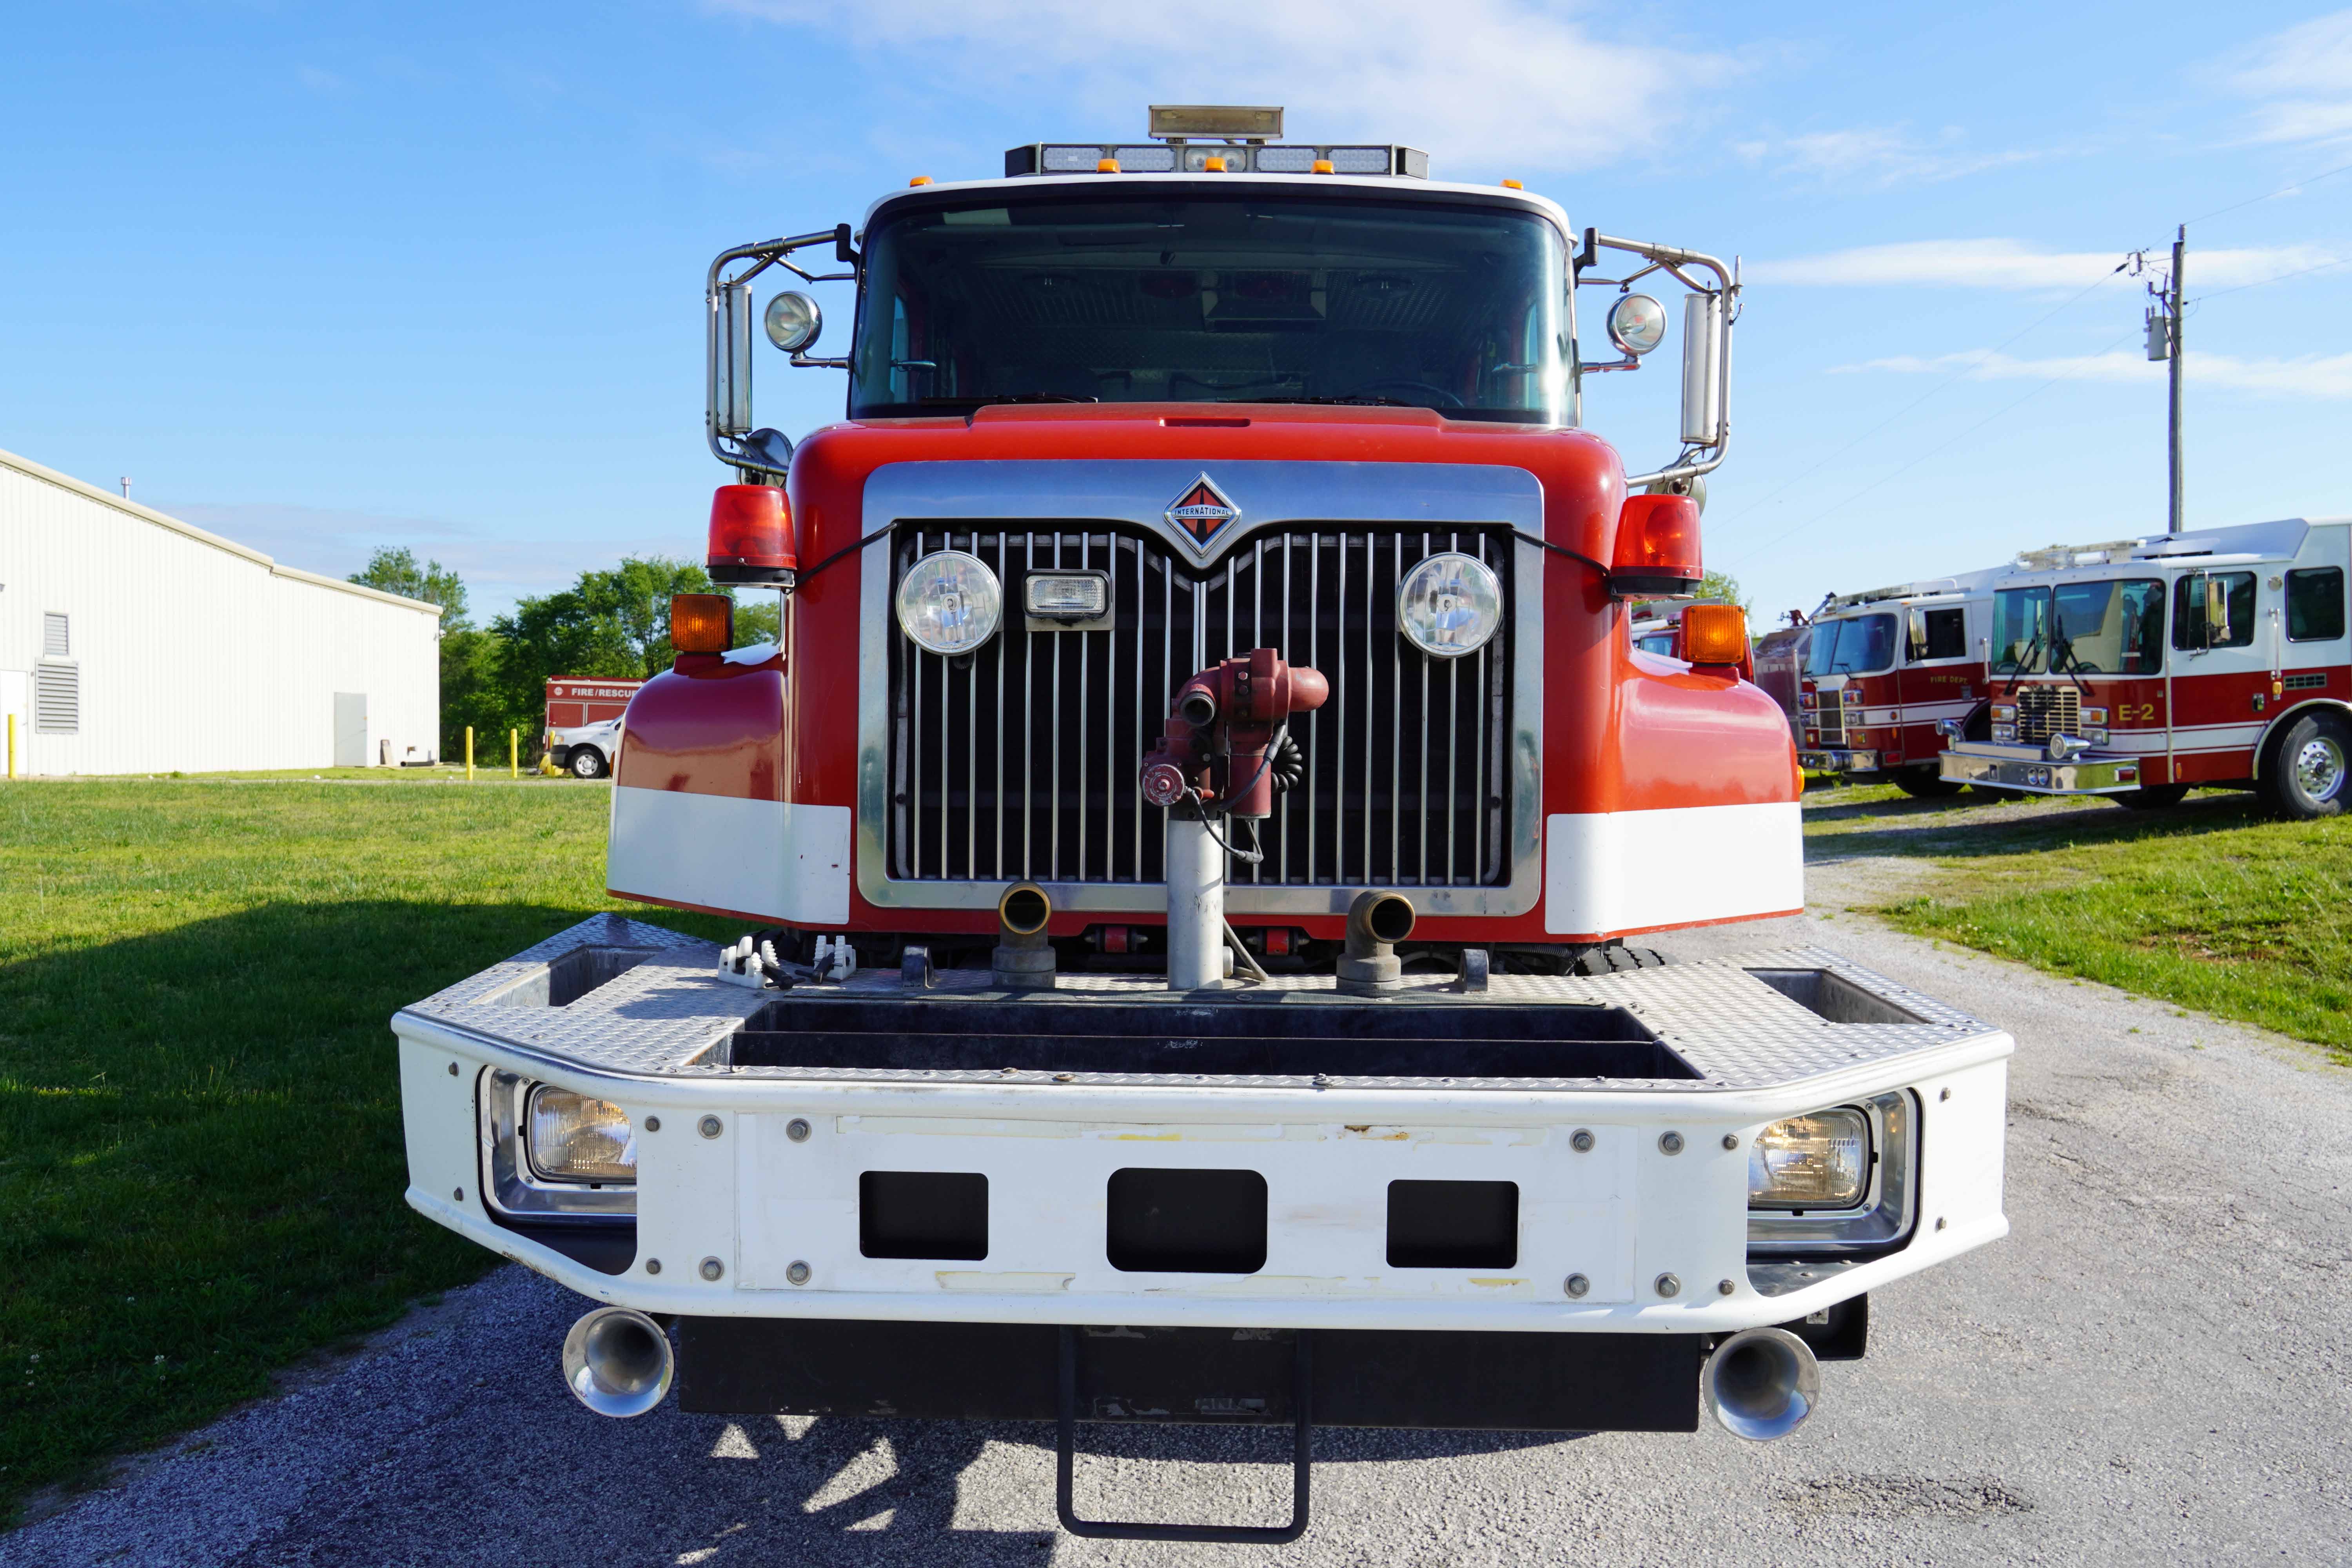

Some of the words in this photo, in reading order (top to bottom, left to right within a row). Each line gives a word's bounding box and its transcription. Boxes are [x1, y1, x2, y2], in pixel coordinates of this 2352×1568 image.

[1175, 507, 1229, 515] INTERNATIONAL
[1930, 675, 1947, 684] FIRE
[2119, 704, 2154, 721] E-2
